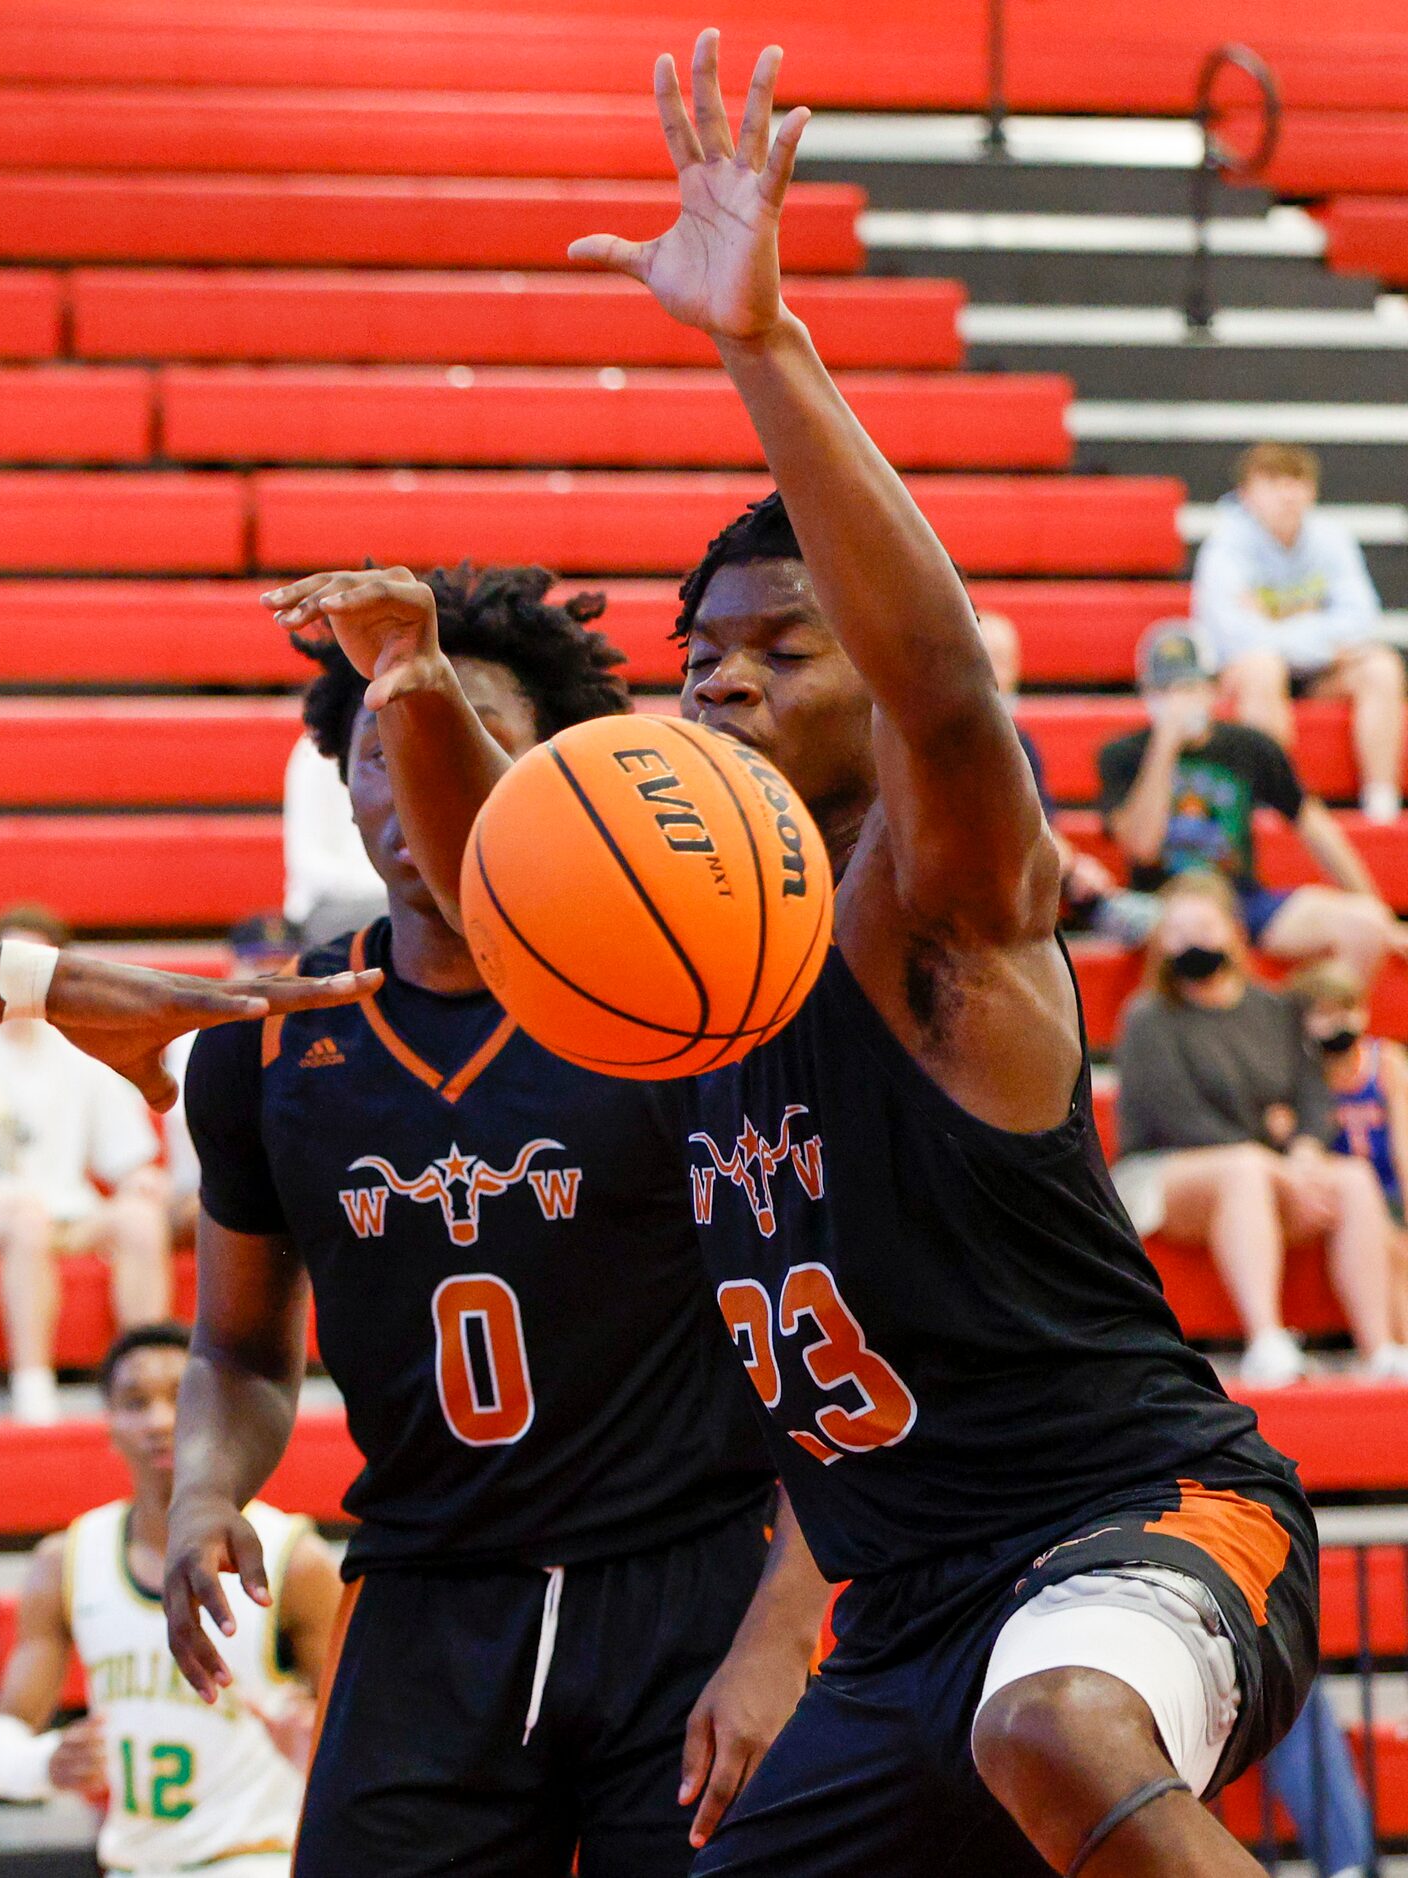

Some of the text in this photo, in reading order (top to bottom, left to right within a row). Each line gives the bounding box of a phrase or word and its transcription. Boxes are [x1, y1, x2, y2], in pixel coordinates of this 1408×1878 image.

[612, 748, 735, 898] EVO NXT
[339, 1168, 583, 1238] W W
[431, 1273, 535, 1447] 0
[119, 1738, 197, 1821] 12
